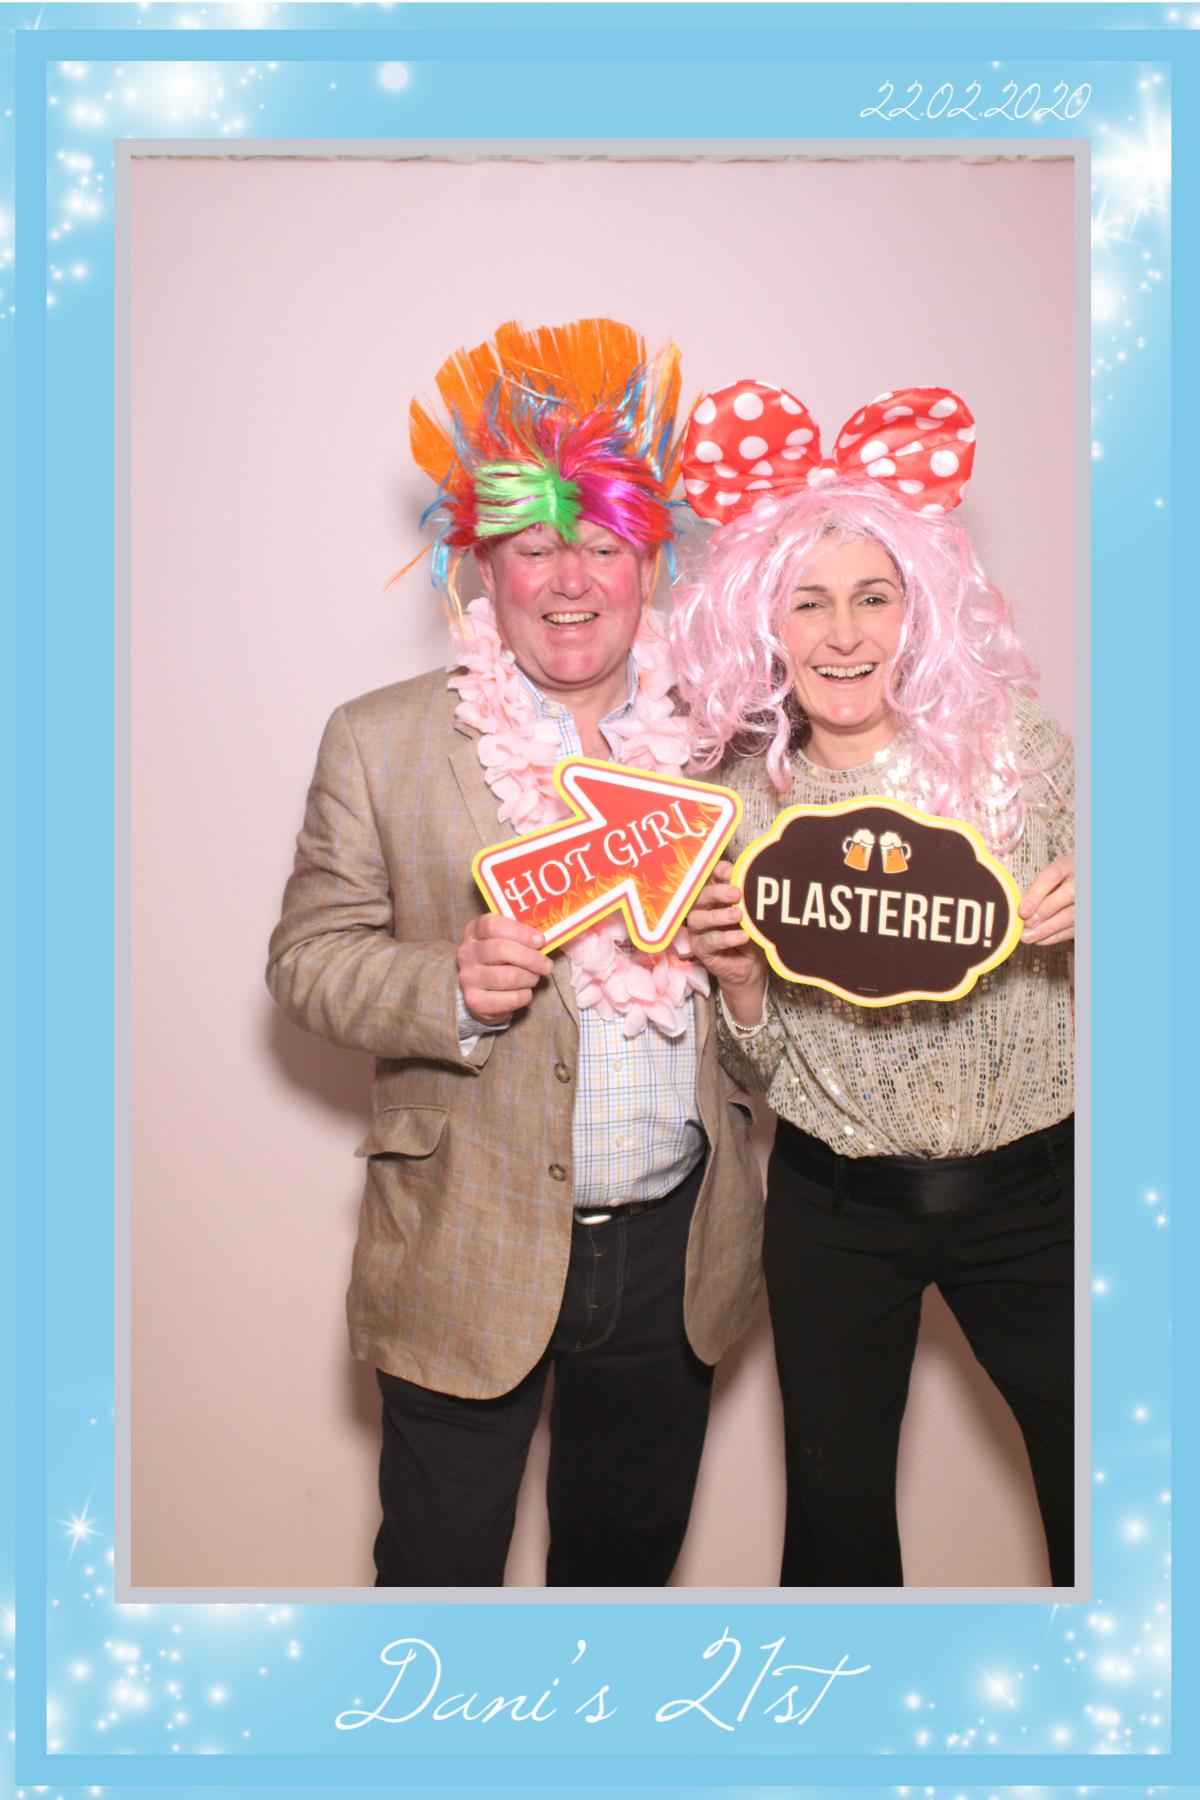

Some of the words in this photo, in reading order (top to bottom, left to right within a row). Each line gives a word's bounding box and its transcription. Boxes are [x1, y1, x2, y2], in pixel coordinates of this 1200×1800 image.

[504, 845, 593, 914] HOT
[602, 799, 708, 869] GIRL
[755, 875, 996, 949] PLASTERED!
